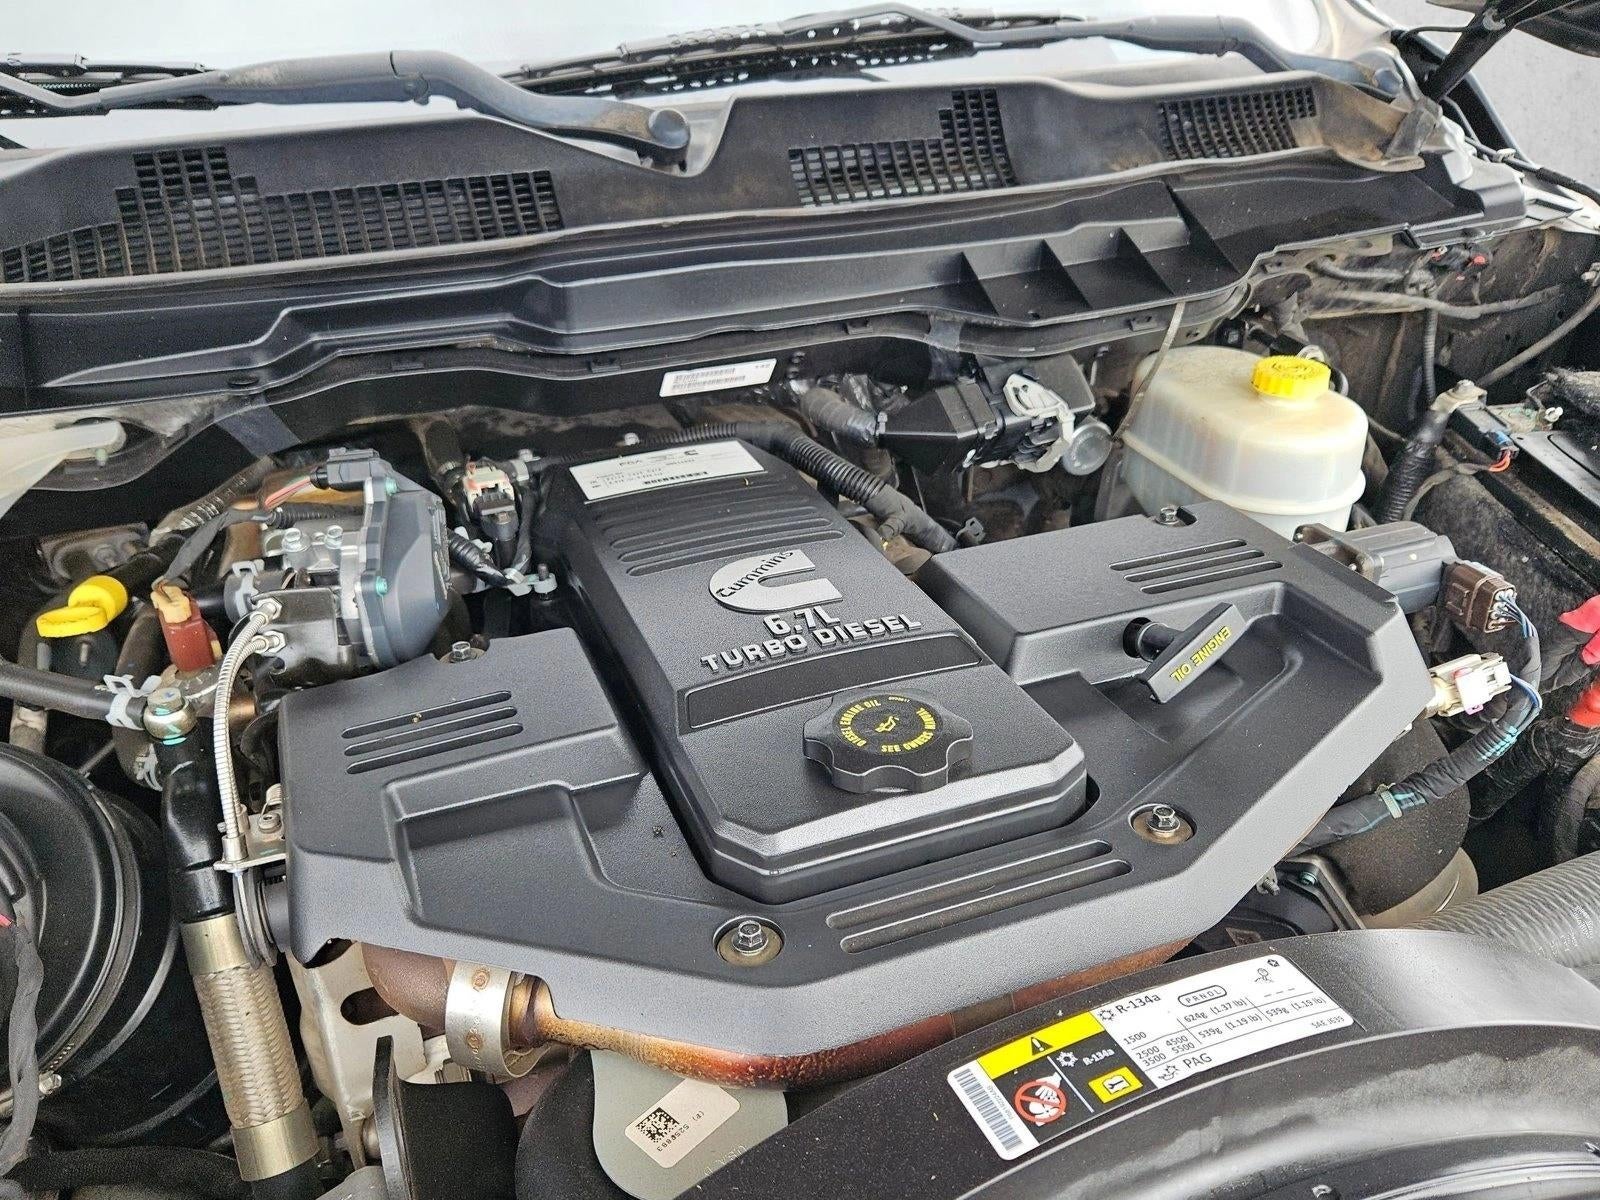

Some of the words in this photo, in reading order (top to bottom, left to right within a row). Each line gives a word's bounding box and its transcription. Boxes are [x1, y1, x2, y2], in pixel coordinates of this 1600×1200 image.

[716, 550, 794, 597] Cummins
[763, 605, 840, 636] 6.7L
[701, 634, 807, 673] TURBO
[813, 614, 921, 647] DIESEL
[1190, 626, 1231, 667] ENGINE
[1170, 664, 1192, 682] OIL
[840, 704, 864, 725] ENGINE
[863, 700, 881, 708] OIL
[841, 726, 867, 747] DIESEL
[1115, 994, 1162, 1014] R-134a
[1184, 1012, 1208, 1023] 624g
[1210, 1002, 1232, 1015] (1.37
[1235, 997, 1248, 1007] lb)
[1265, 1007, 1290, 1018] 539g
[1291, 1000, 1311, 1011] (1.19
[1312, 996, 1327, 1005] lb)
[1198, 1028, 1223, 1039] 539g
[1224, 1018, 1248, 1032] (1.19
[1249, 1013, 1264, 1024] lb)
[1124, 1032, 1147, 1045] 1500
[1136, 1045, 1160, 1060] 2500
[1165, 1035, 1188, 1047] 4500
[1082, 1049, 1115, 1066] R-134a
[1143, 1053, 1167, 1067] 3500
[1172, 1042, 1195, 1054] 5500
[1183, 1053, 1213, 1069] PAG
